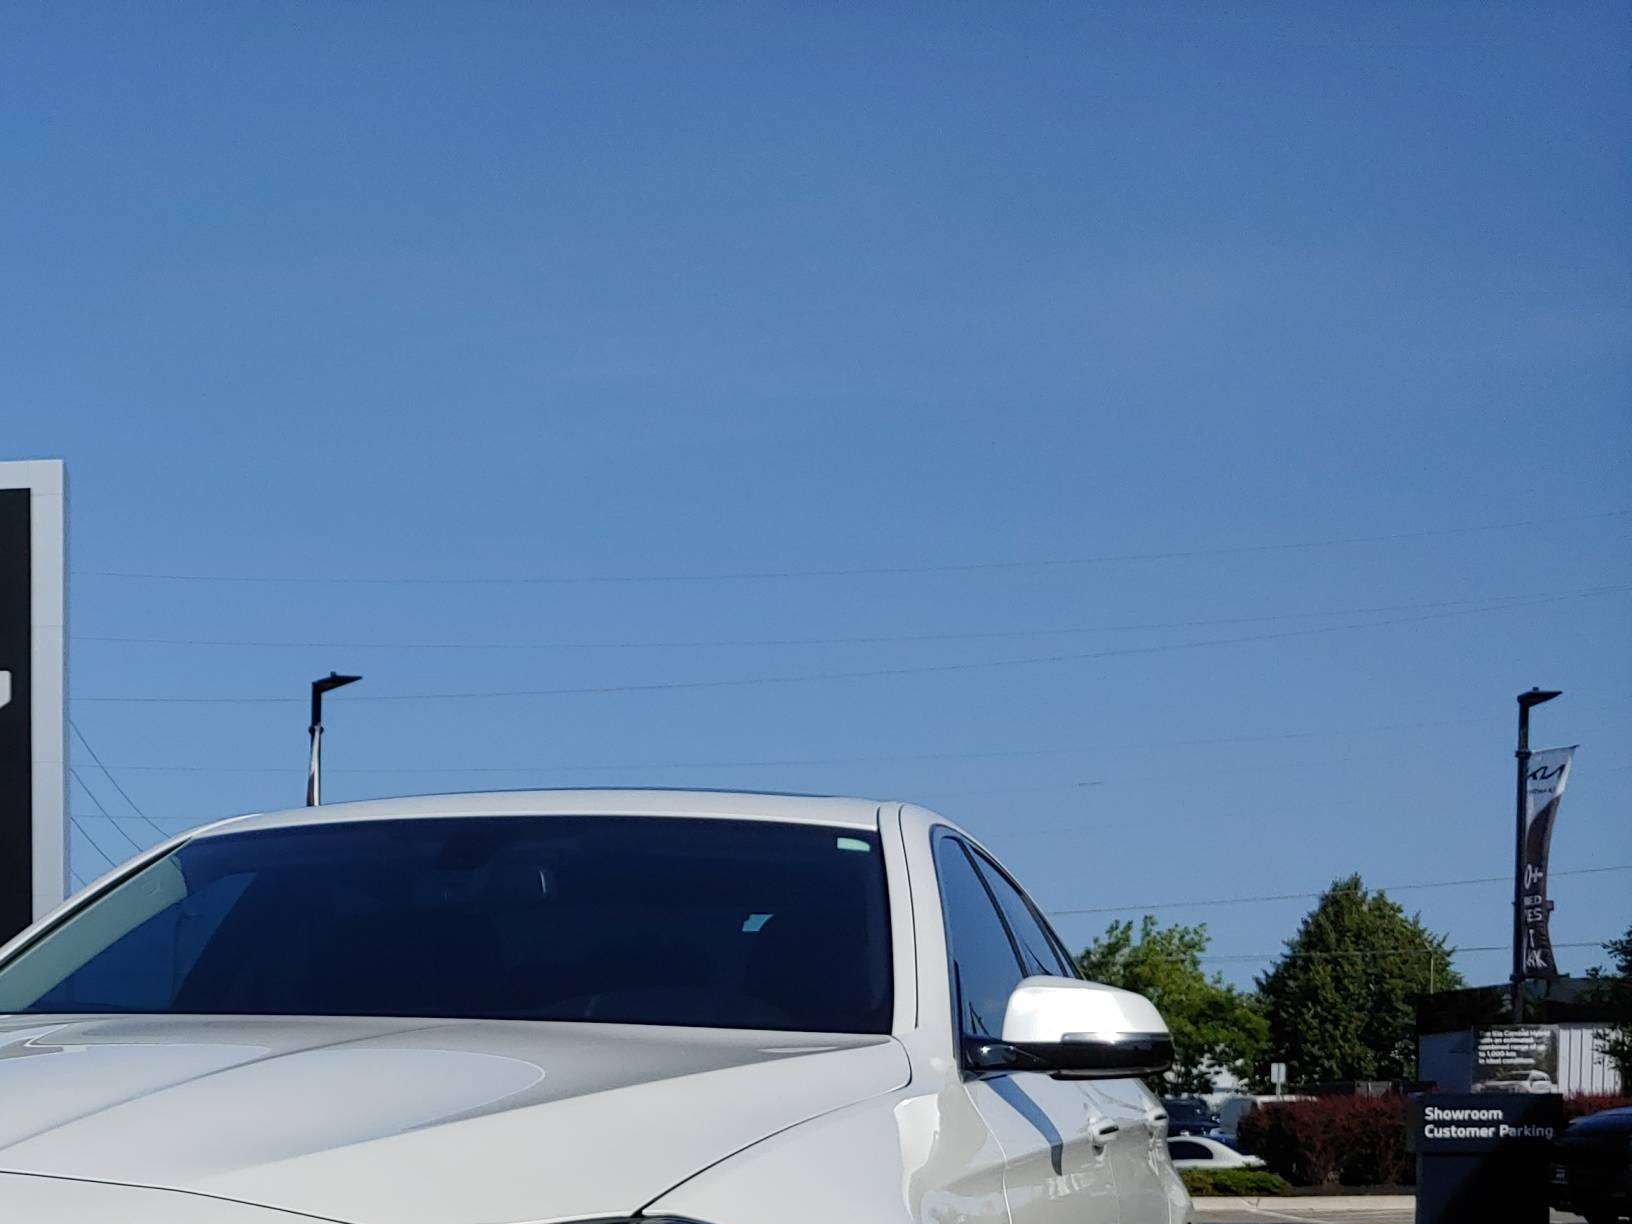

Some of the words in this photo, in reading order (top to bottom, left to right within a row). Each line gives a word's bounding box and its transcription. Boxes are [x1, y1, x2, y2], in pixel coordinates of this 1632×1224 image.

[1424, 1106, 1504, 1121] Showroom
[1424, 1124, 1496, 1138] Customer
[1499, 1124, 1554, 1140] Parking
